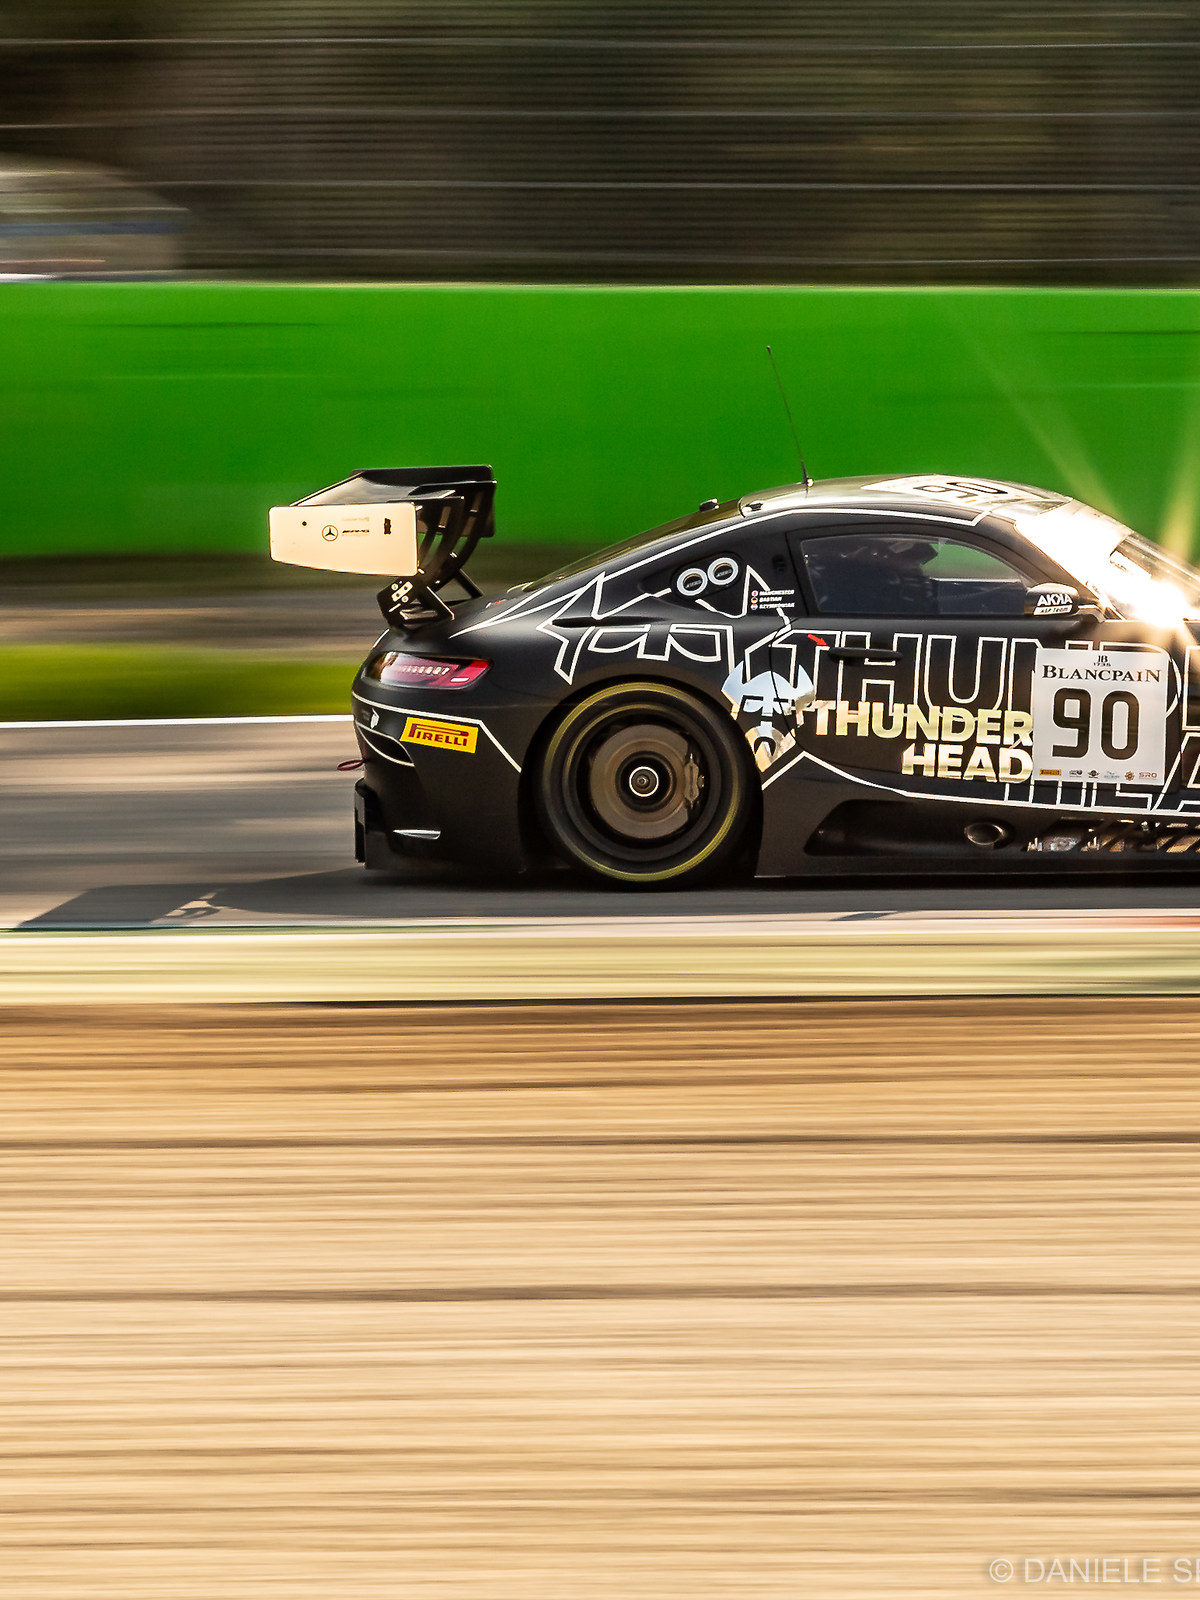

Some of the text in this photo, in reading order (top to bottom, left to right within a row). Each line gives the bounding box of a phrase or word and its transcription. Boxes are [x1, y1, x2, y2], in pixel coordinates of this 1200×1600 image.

[1036, 593, 1073, 607] AKKA
[1042, 665, 1161, 682] BLANCPAIN
[408, 723, 470, 746] PIRELLI
[814, 699, 1034, 747] THUNDER
[1051, 687, 1140, 761] 90
[901, 742, 1034, 784] HEAD
[1138, 771, 1158, 779] SRO
